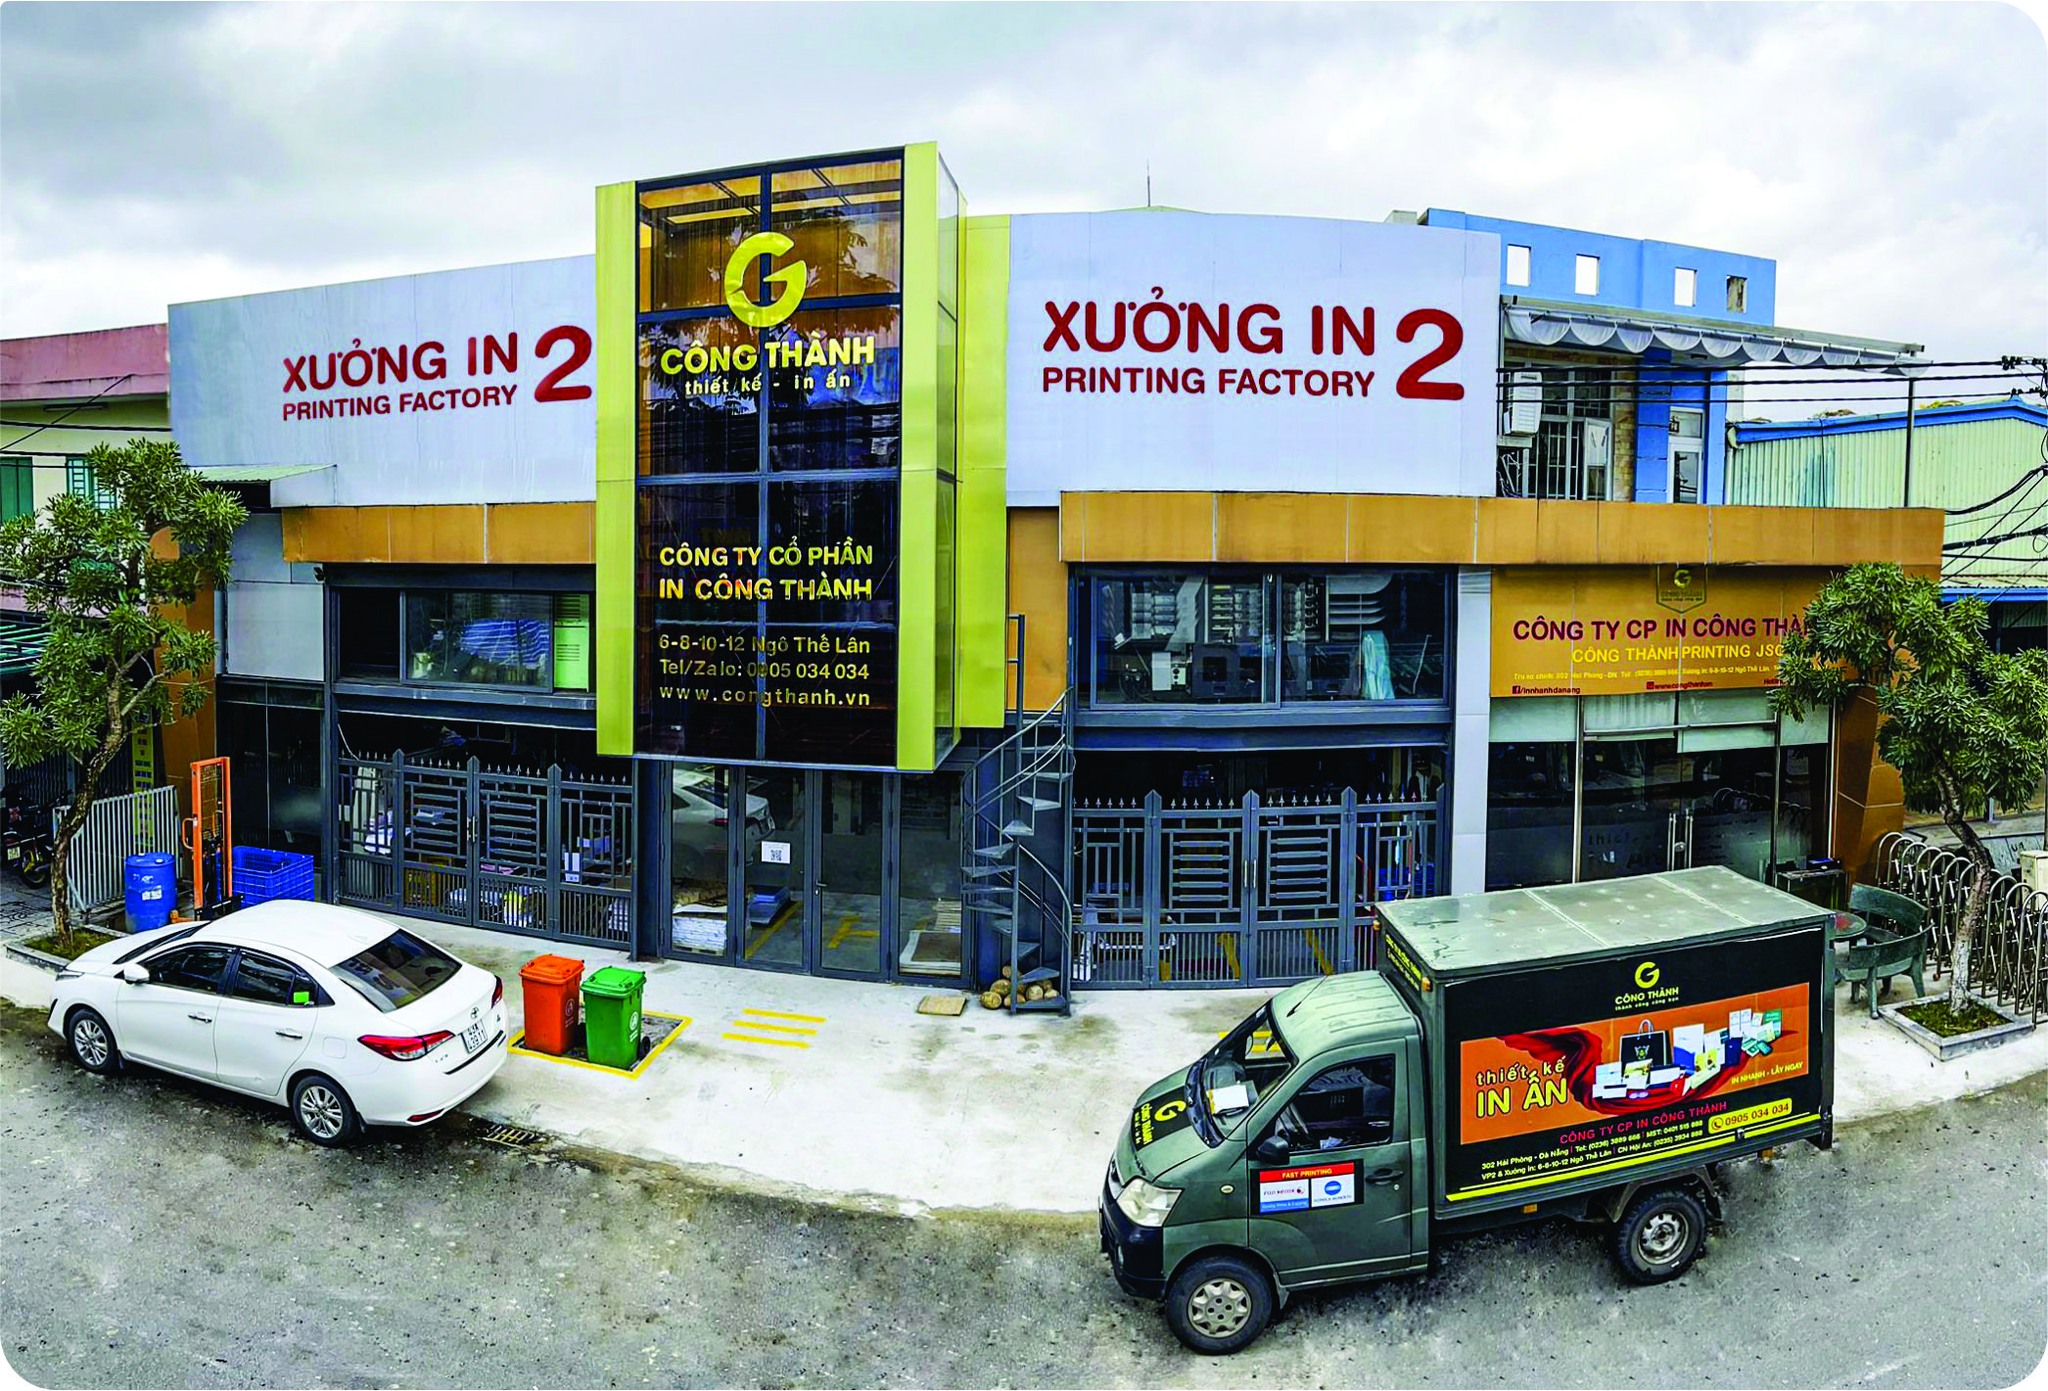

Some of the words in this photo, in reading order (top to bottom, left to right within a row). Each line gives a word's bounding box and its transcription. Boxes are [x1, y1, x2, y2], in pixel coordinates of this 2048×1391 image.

[660, 339, 758, 375] CÔNG
[765, 330, 875, 369] THÀNH
[1043, 286, 1283, 354] XƯỞNG
[1312, 305, 1375, 356] IN
[1396, 308, 1465, 400] 2
[282, 336, 447, 393] XƯỞNG
[468, 331, 517, 376] IN
[534, 325, 592, 403] 2
[685, 375, 729, 396] thiết
[741, 372, 762, 392] kế
[794, 374, 815, 390] in
[826, 369, 850, 389] ấn
[1043, 366, 1205, 394] PRINTING
[1218, 368, 1375, 397] FACTORY
[282, 395, 391, 421] PRINTING
[399, 384, 517, 413] FACTORY
[659, 542, 728, 566] CÔNG
[733, 546, 762, 566] TY
[769, 535, 802, 566] CỔ
[808, 536, 873, 566] PHẦN
[659, 577, 684, 600] IN
[695, 572, 773, 601] CÔNG
[780, 571, 872, 601] THÀNH
[1513, 615, 1584, 641] CÔNG
[1591, 620, 1620, 640] TY
[1626, 619, 1657, 639] CP
[1666, 618, 1687, 638] IN
[1692, 613, 1757, 638] CÔNG
[658, 634, 745, 652] 6-8-10-12
[752, 636, 789, 656] Ngô
[794, 633, 830, 653] Thế
[835, 636, 870, 654] Lân
[1572, 646, 1620, 663] CÔNG
[1625, 644, 1679, 661] THÀNH
[1681, 644, 1750, 660] PRINTING
[659, 659, 742, 677] Tel/Zalo:
[796, 663, 831, 679] 034
[834, 663, 870, 680] 034
[1615, 993, 1645, 1005] CÔNG
[1647, 986, 1679, 1000] THÀNH
[1477, 1063, 1527, 1086] thiết
[1543, 1055, 1566, 1076] kế
[1741, 1070, 1766, 1083] NHANH
[1477, 1086, 1510, 1118] IN
[1522, 1070, 1567, 1111] ẤN
[1559, 1130, 1595, 1145] CÔNG
[1600, 1125, 1614, 1137] TY
[1617, 1121, 1633, 1133] CP
[1636, 1118, 1649, 1129] IN
[1652, 1110, 1685, 1126] CÔNG
[1689, 1101, 1728, 1118] THÀNH
[1725, 1112, 1749, 1126] 0905
[1751, 1107, 1769, 1120] 034
[1772, 1103, 1789, 1115] 034
[1617, 1146, 1628, 1154] CN
[1282, 1171, 1299, 1180] FAST
[1300, 1168, 1333, 1178] PRINTING
[1481, 1162, 1496, 1170] 302
